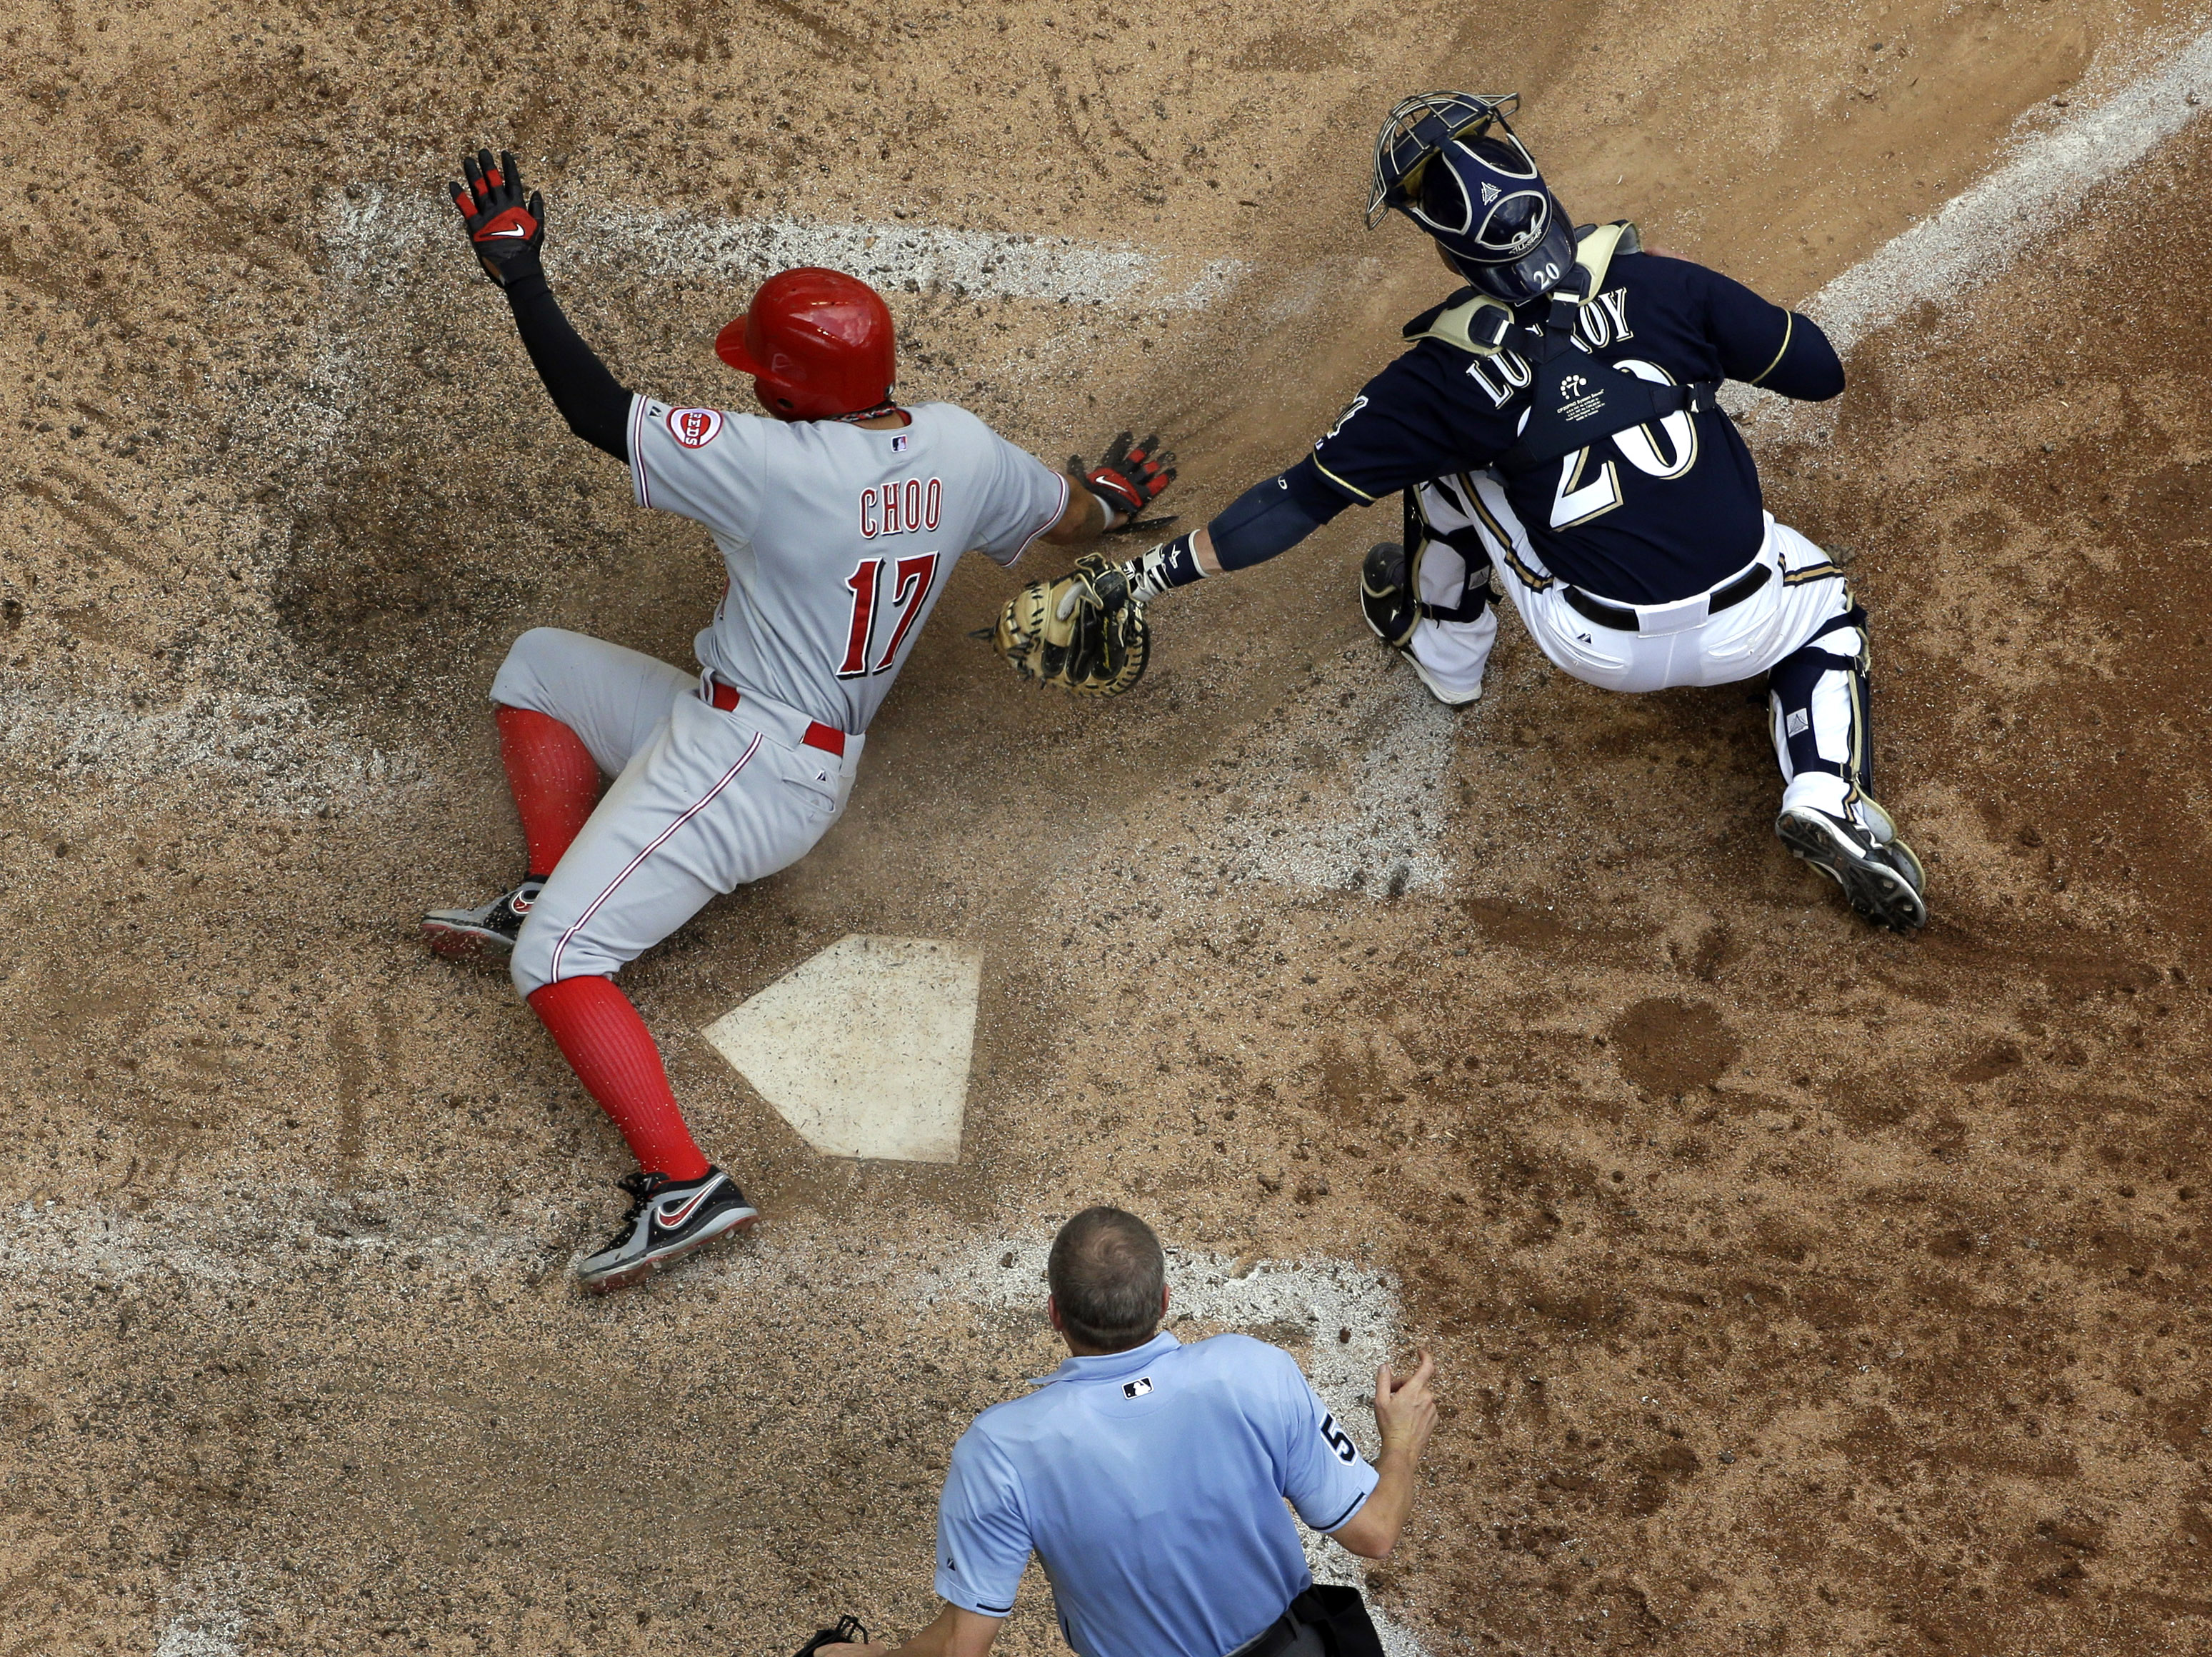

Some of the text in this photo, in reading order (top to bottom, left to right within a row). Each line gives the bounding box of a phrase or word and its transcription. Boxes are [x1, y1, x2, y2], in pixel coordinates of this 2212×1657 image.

[1533, 263, 1560, 290] 20
[1466, 287, 1633, 409] LUOY
[685, 412, 702, 446] REDS
[1517, 359, 1697, 531] 20
[859, 476, 943, 539] CHOO
[835, 551, 939, 680] 17
[1319, 1410, 1358, 1466] 5
